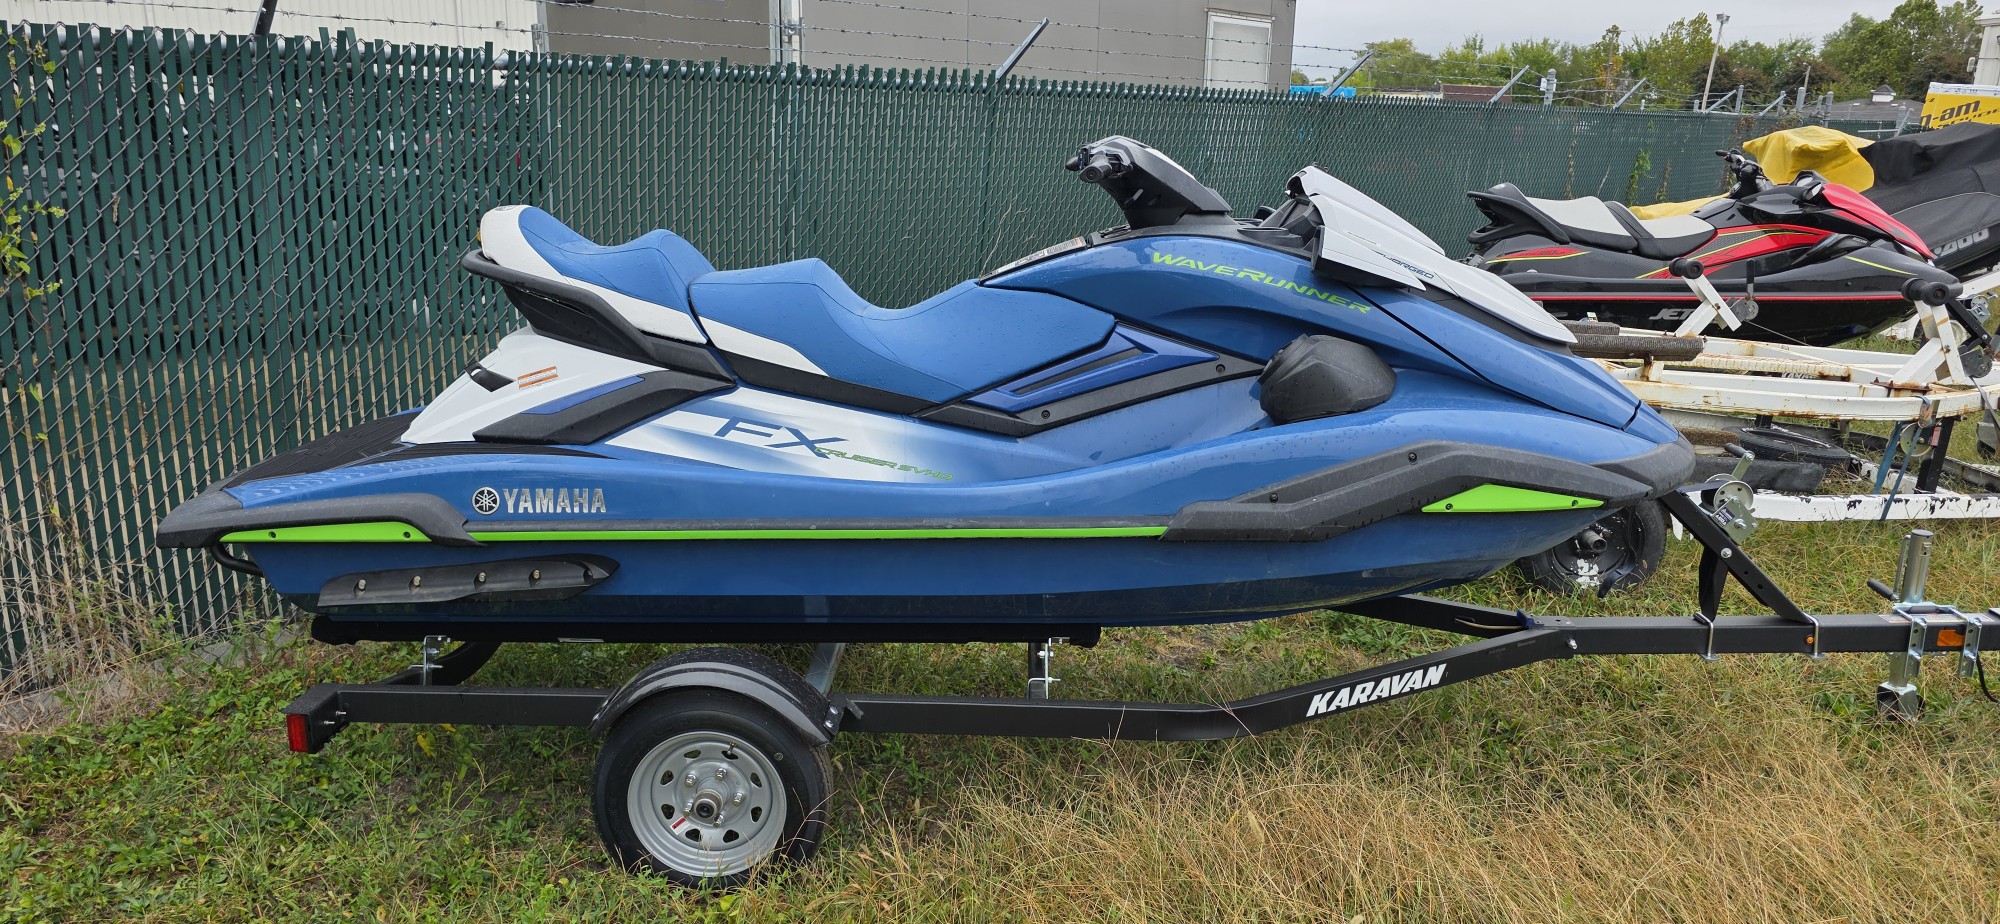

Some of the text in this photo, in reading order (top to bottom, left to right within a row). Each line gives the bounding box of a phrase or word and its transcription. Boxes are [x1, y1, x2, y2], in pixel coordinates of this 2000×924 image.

[1648, 308, 1697, 320] JET
[714, 416, 849, 460] FX
[815, 446, 898, 469] CRUISER
[502, 487, 607, 513] YAMAHA
[1306, 663, 1447, 718] KARAVAN
